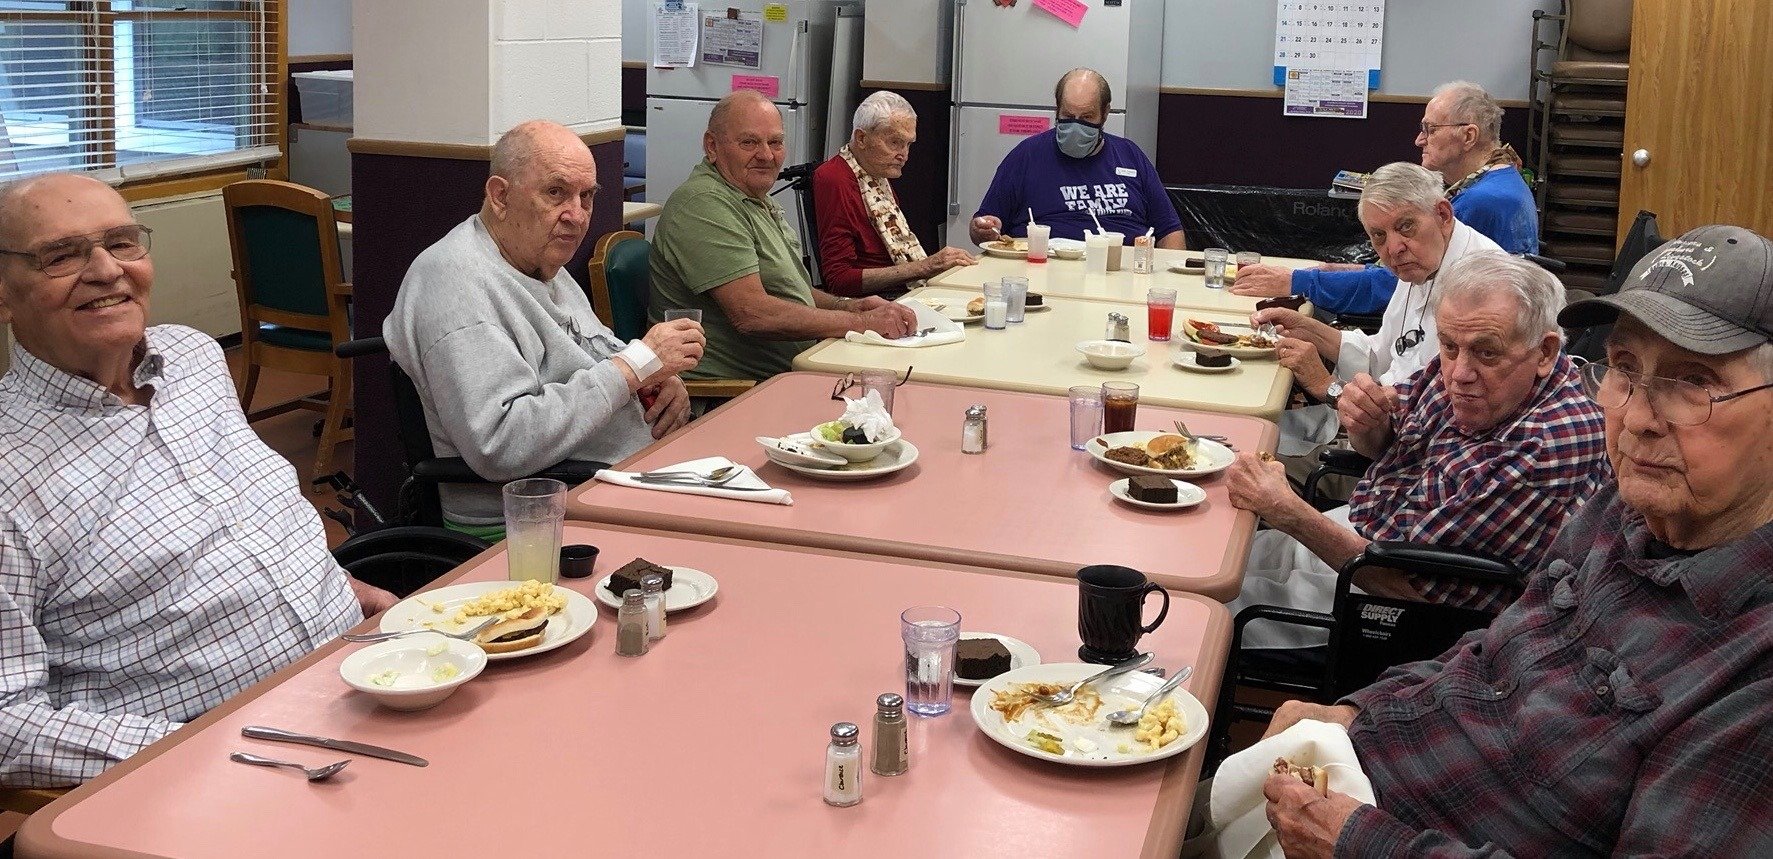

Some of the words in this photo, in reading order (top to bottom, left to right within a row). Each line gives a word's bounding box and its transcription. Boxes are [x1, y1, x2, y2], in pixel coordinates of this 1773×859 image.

[1060, 185, 1090, 200] WE
[1094, 183, 1129, 198] ARE
[1363, 604, 1405, 616] DIRECT
[1361, 612, 1399, 623] SUPPLY
